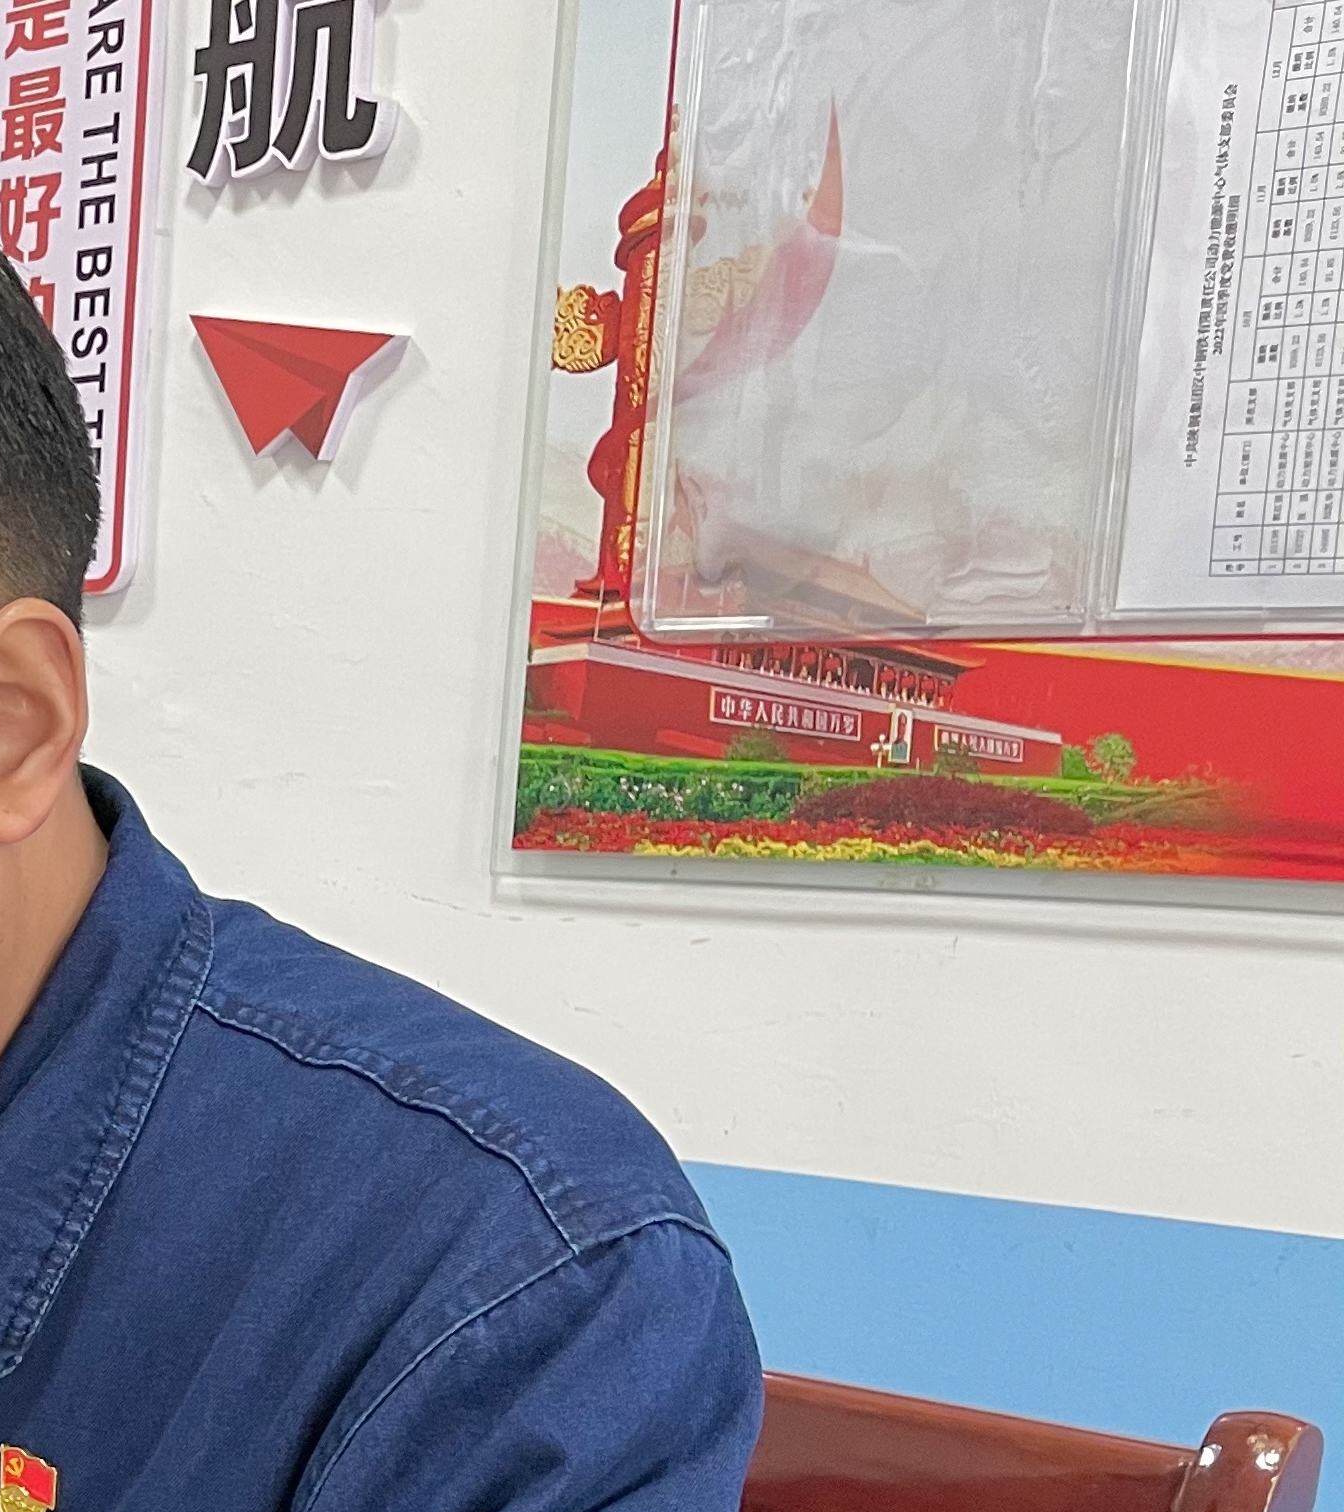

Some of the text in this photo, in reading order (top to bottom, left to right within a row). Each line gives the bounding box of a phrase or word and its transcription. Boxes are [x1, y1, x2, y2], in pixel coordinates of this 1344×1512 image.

[186, 0, 379, 180] 航
[78, 112, 120, 229] THE
[71, 245, 113, 393] BEST
